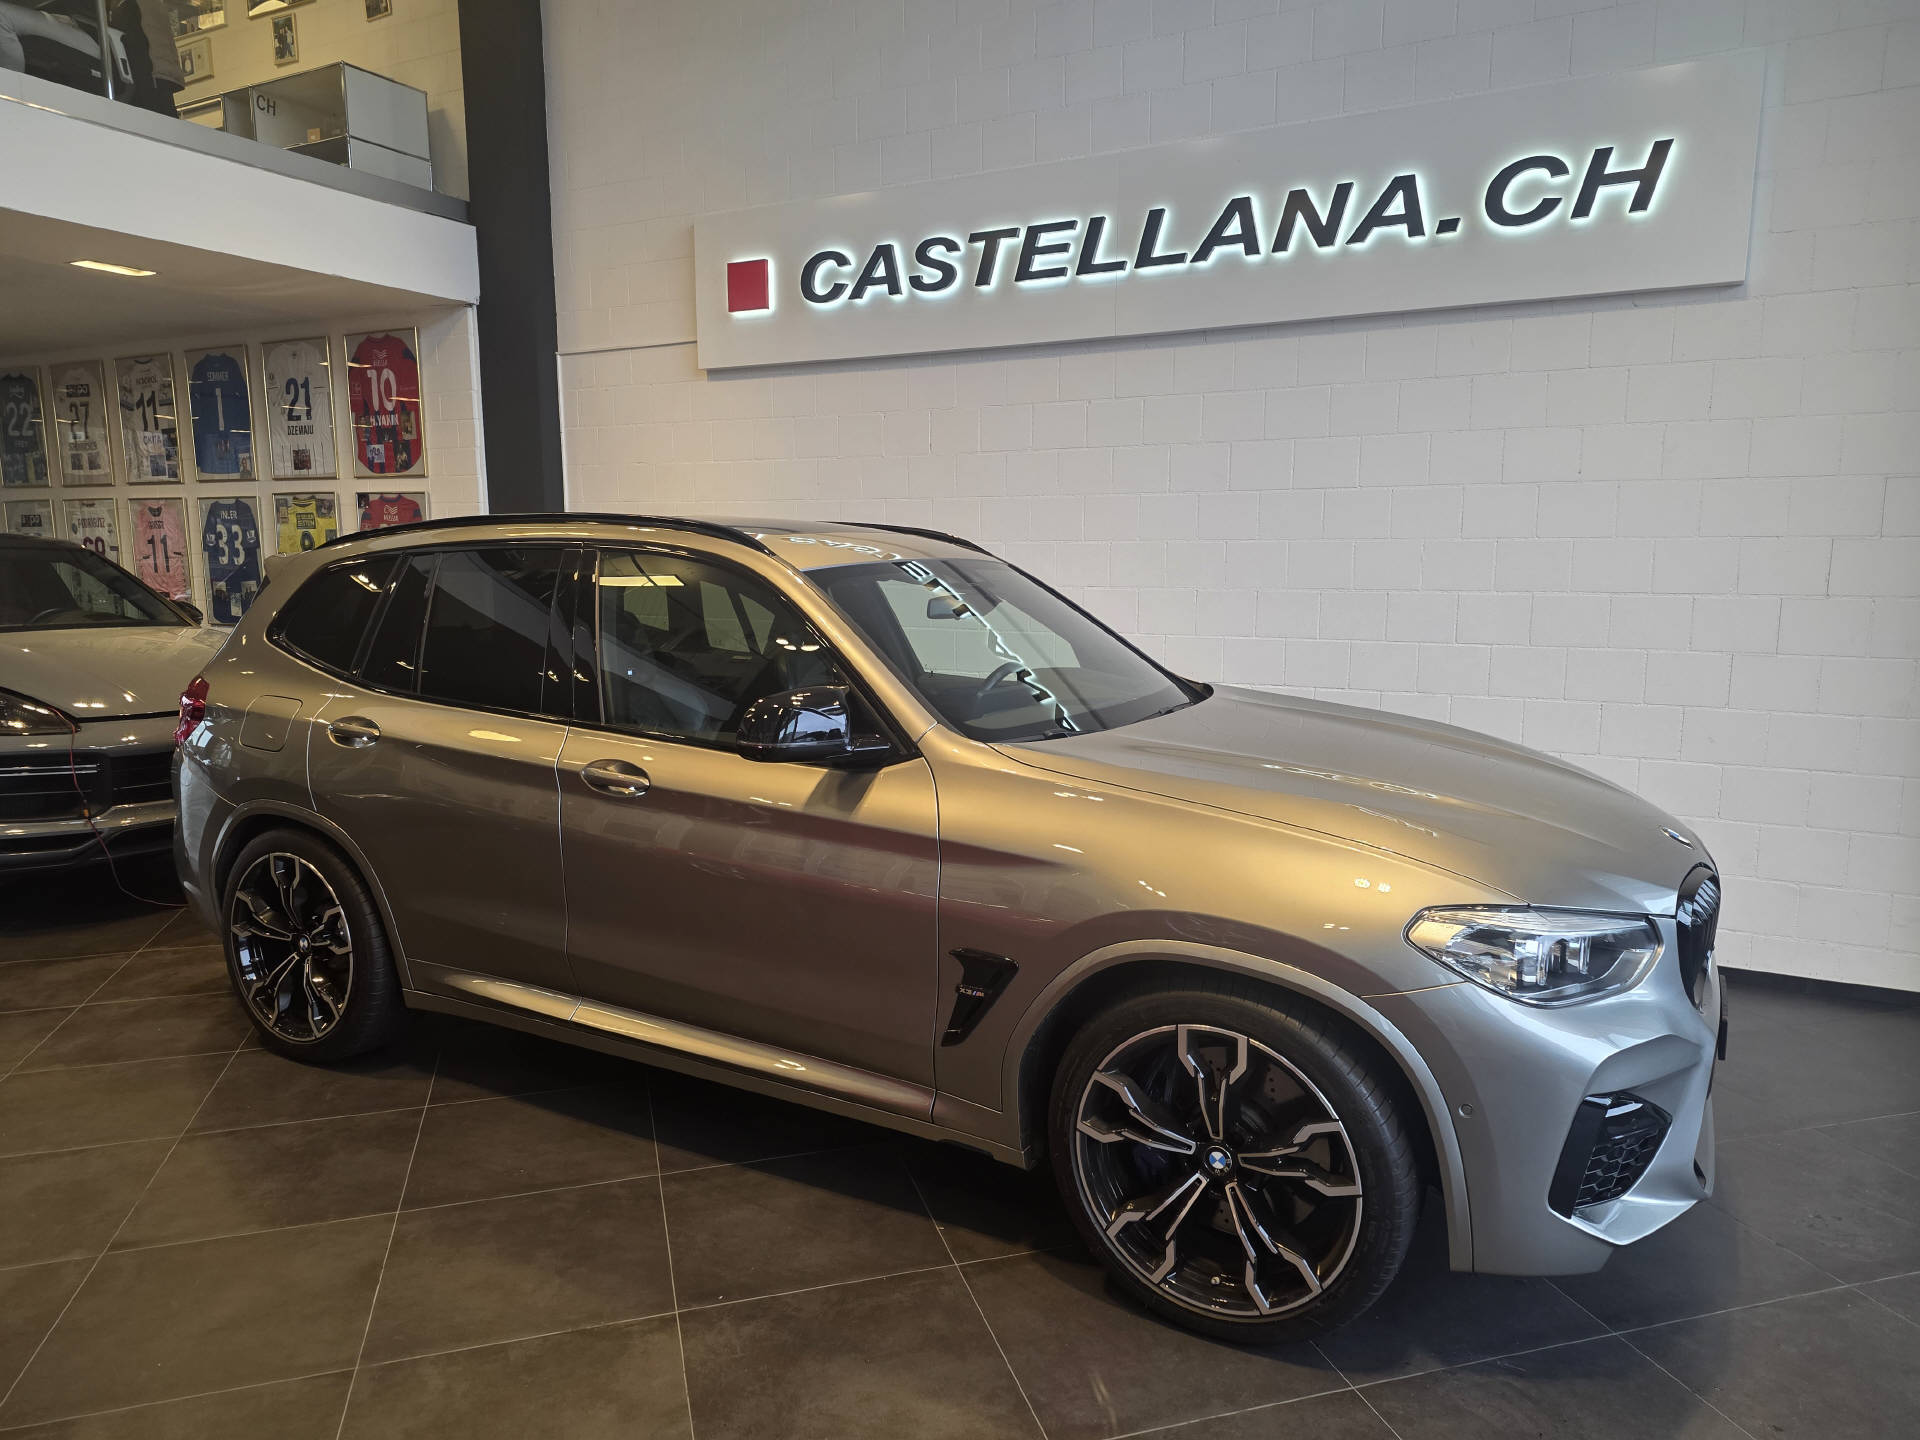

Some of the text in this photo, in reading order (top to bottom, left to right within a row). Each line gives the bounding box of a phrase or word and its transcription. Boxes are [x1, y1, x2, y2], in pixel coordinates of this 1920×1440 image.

[256, 94, 277, 116] CH
[798, 136, 1674, 306] CASTELLANA.CH
[135, 389, 160, 432] 11
[215, 387, 225, 432] 1
[285, 375, 313, 422] 21
[366, 367, 398, 412] 10
[6, 401, 34, 437] 22
[146, 533, 171, 574] 11
[215, 523, 246, 567] 33
